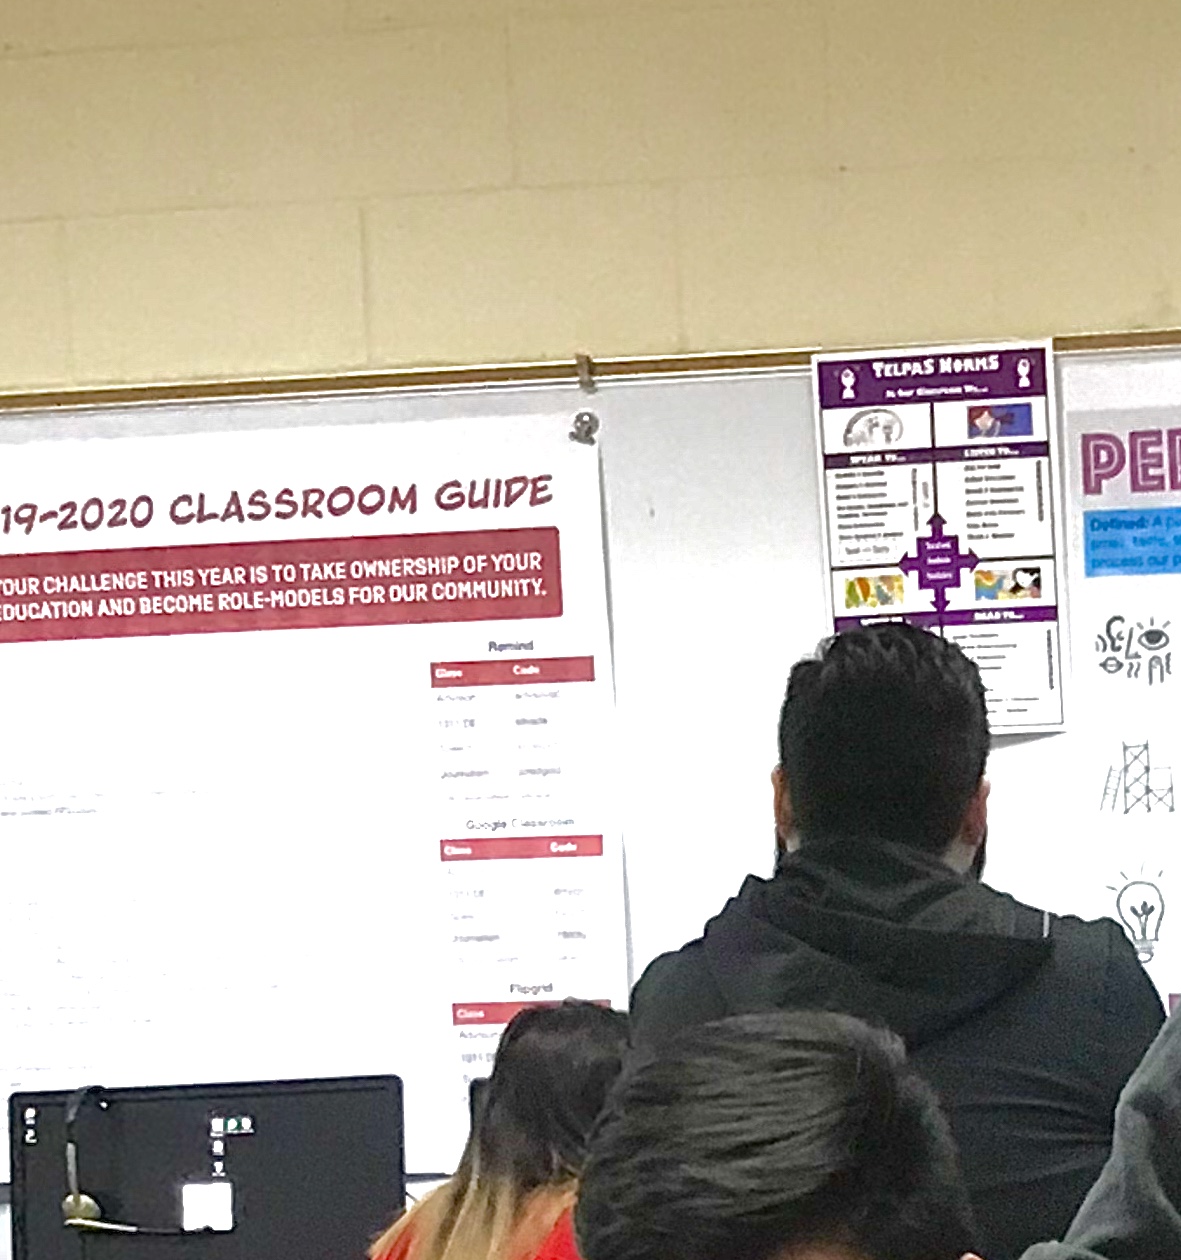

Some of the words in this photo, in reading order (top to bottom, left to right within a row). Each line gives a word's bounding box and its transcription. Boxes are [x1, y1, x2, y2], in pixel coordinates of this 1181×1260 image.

[169, 482, 418, 525] CLASSROOM
[434, 473, 553, 511] GUIDE
[43, 571, 148, 594] CHALLENGE
[151, 569, 194, 588] THIS
[197, 567, 246, 586] YEAR
[250, 566, 268, 583] IS
[271, 564, 296, 583] TO
[300, 561, 346, 581] TAKE
[351, 557, 459, 579] OWNERSHIP
[463, 555, 488, 573] OF
[491, 552, 542, 571] YOUR
[98, 598, 135, 616] AND
[140, 594, 214, 614] BECOME
[218, 588, 345, 611] ROLE-MODELS
[350, 586, 386, 605] FOR
[389, 583, 428, 603] OUR
[431, 578, 548, 601] COMMUNITY.
